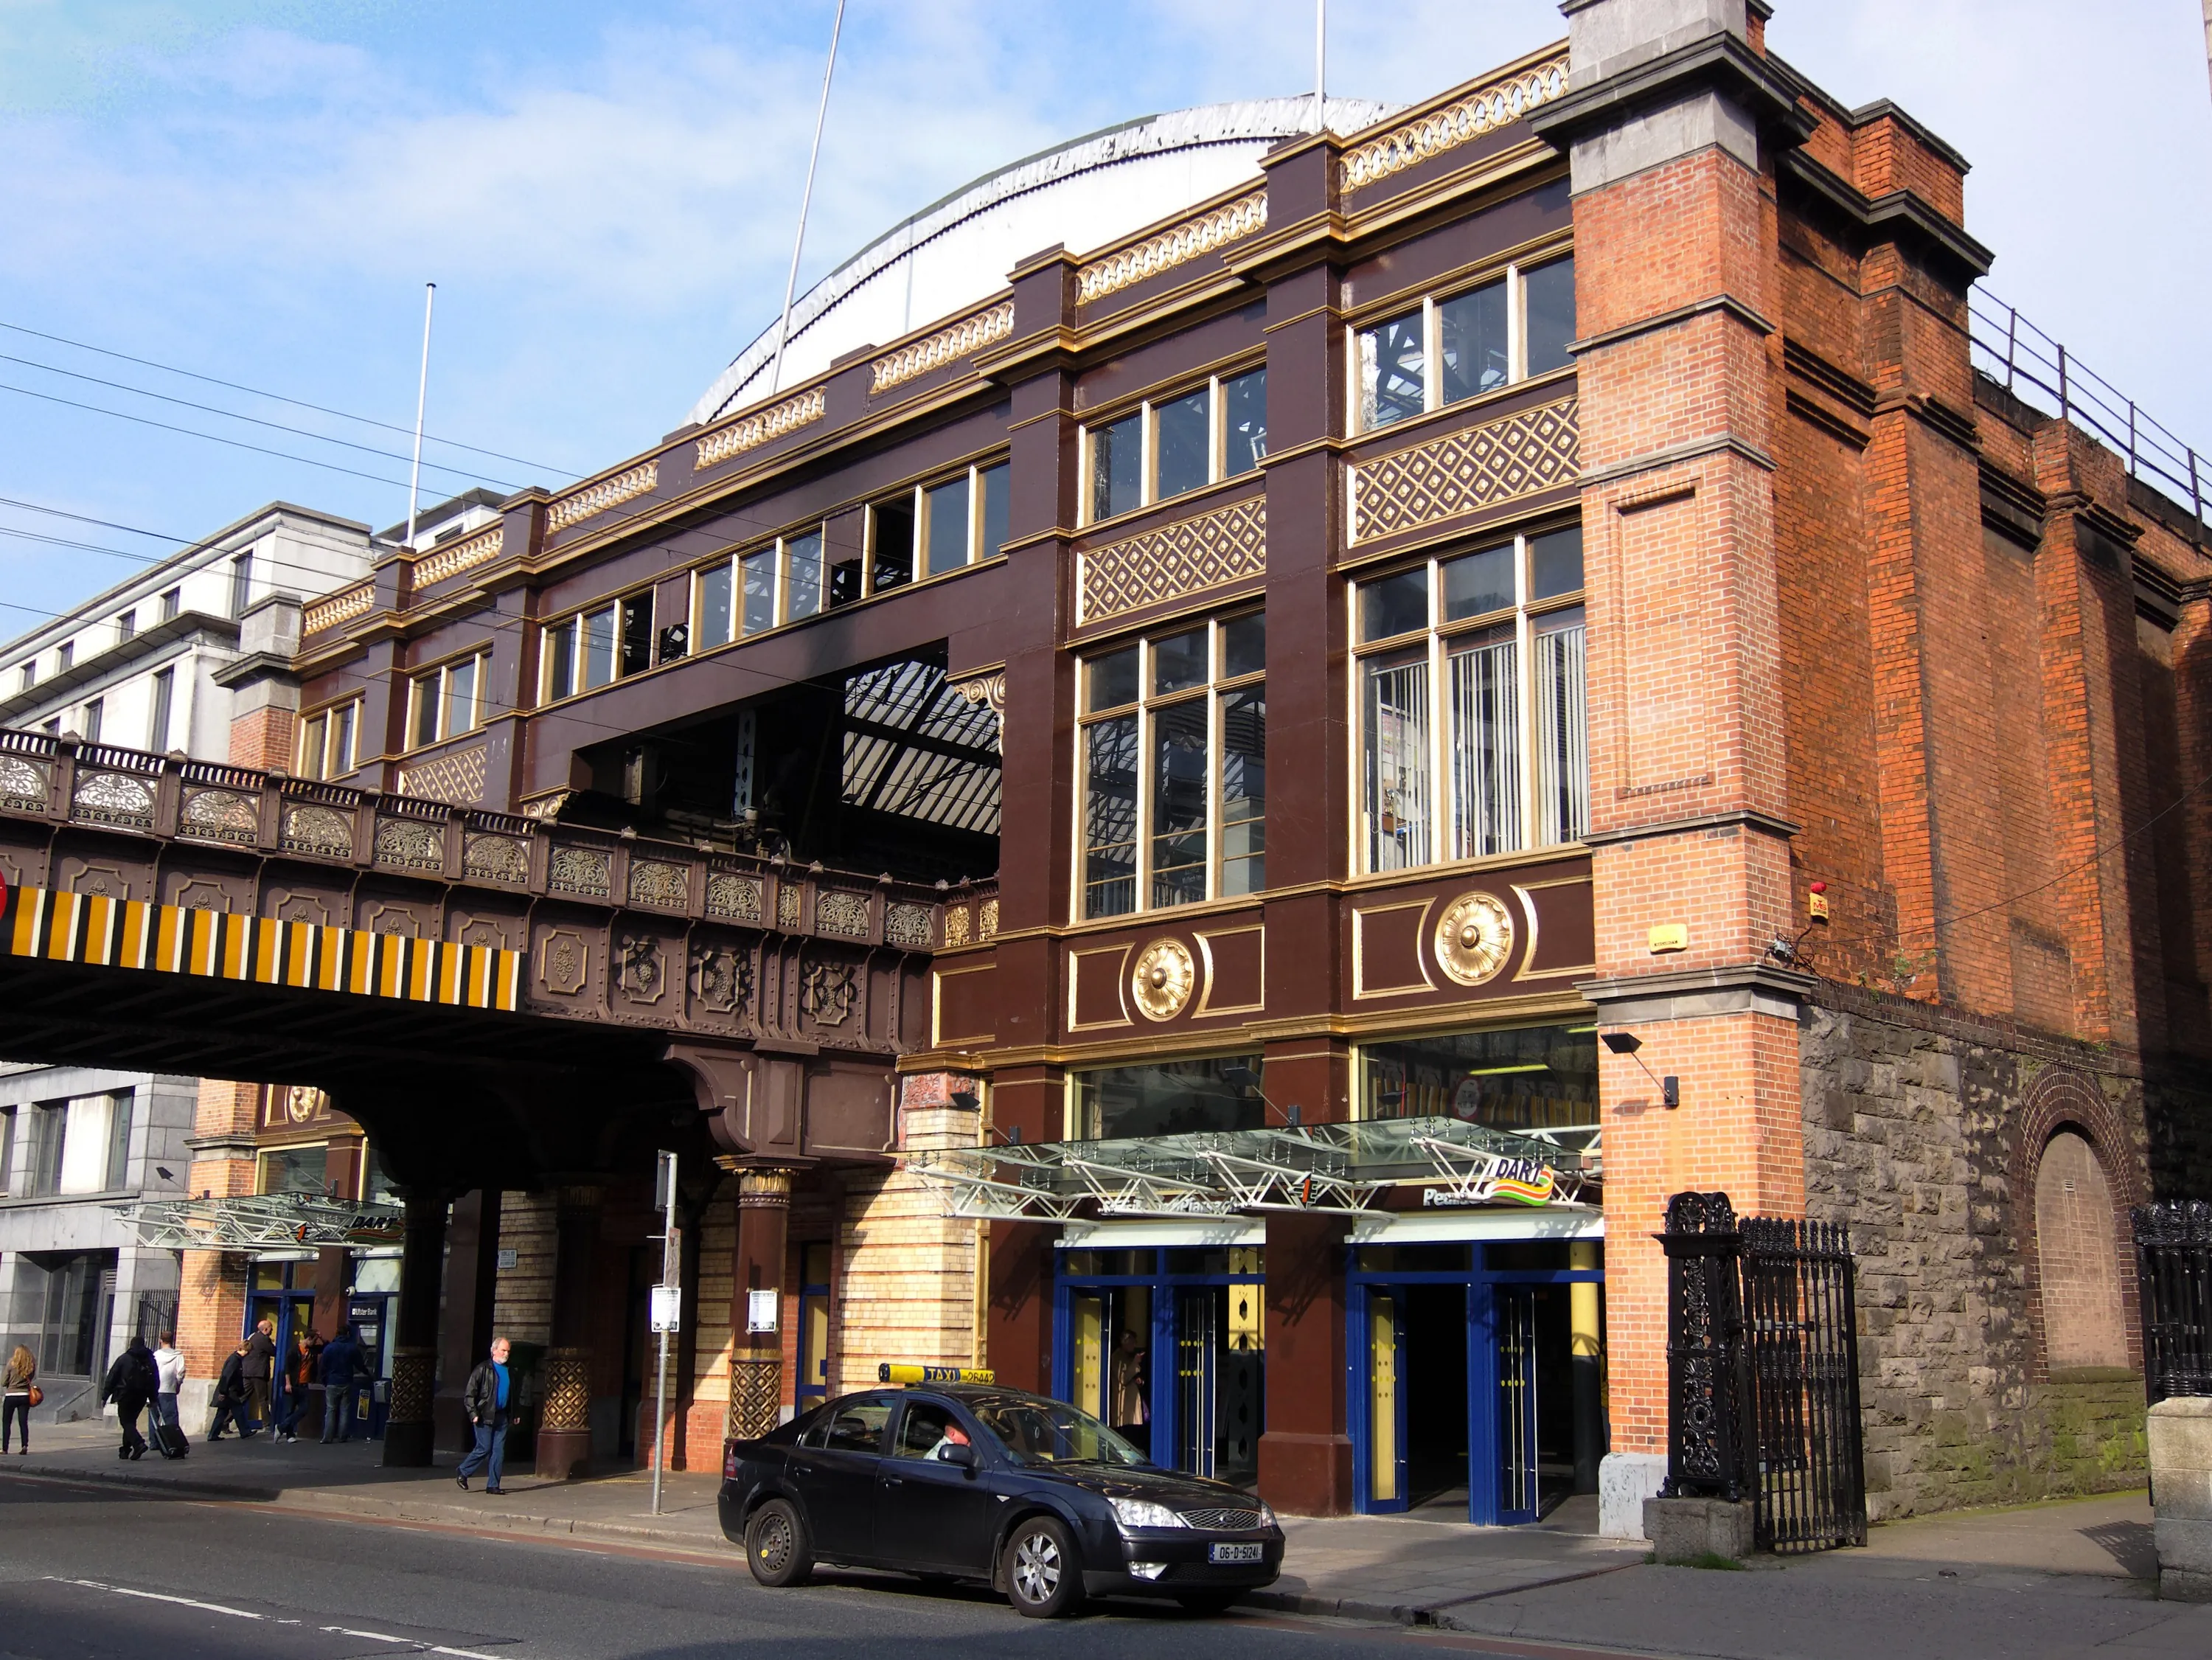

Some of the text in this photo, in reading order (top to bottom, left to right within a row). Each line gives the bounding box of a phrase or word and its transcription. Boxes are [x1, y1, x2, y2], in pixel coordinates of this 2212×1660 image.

[1495, 1159, 1543, 1183] DART
[351, 1216, 398, 1230] DART
[927, 1367, 956, 1383] TAXI
[1220, 1546, 1259, 1559] 06-D-51241
